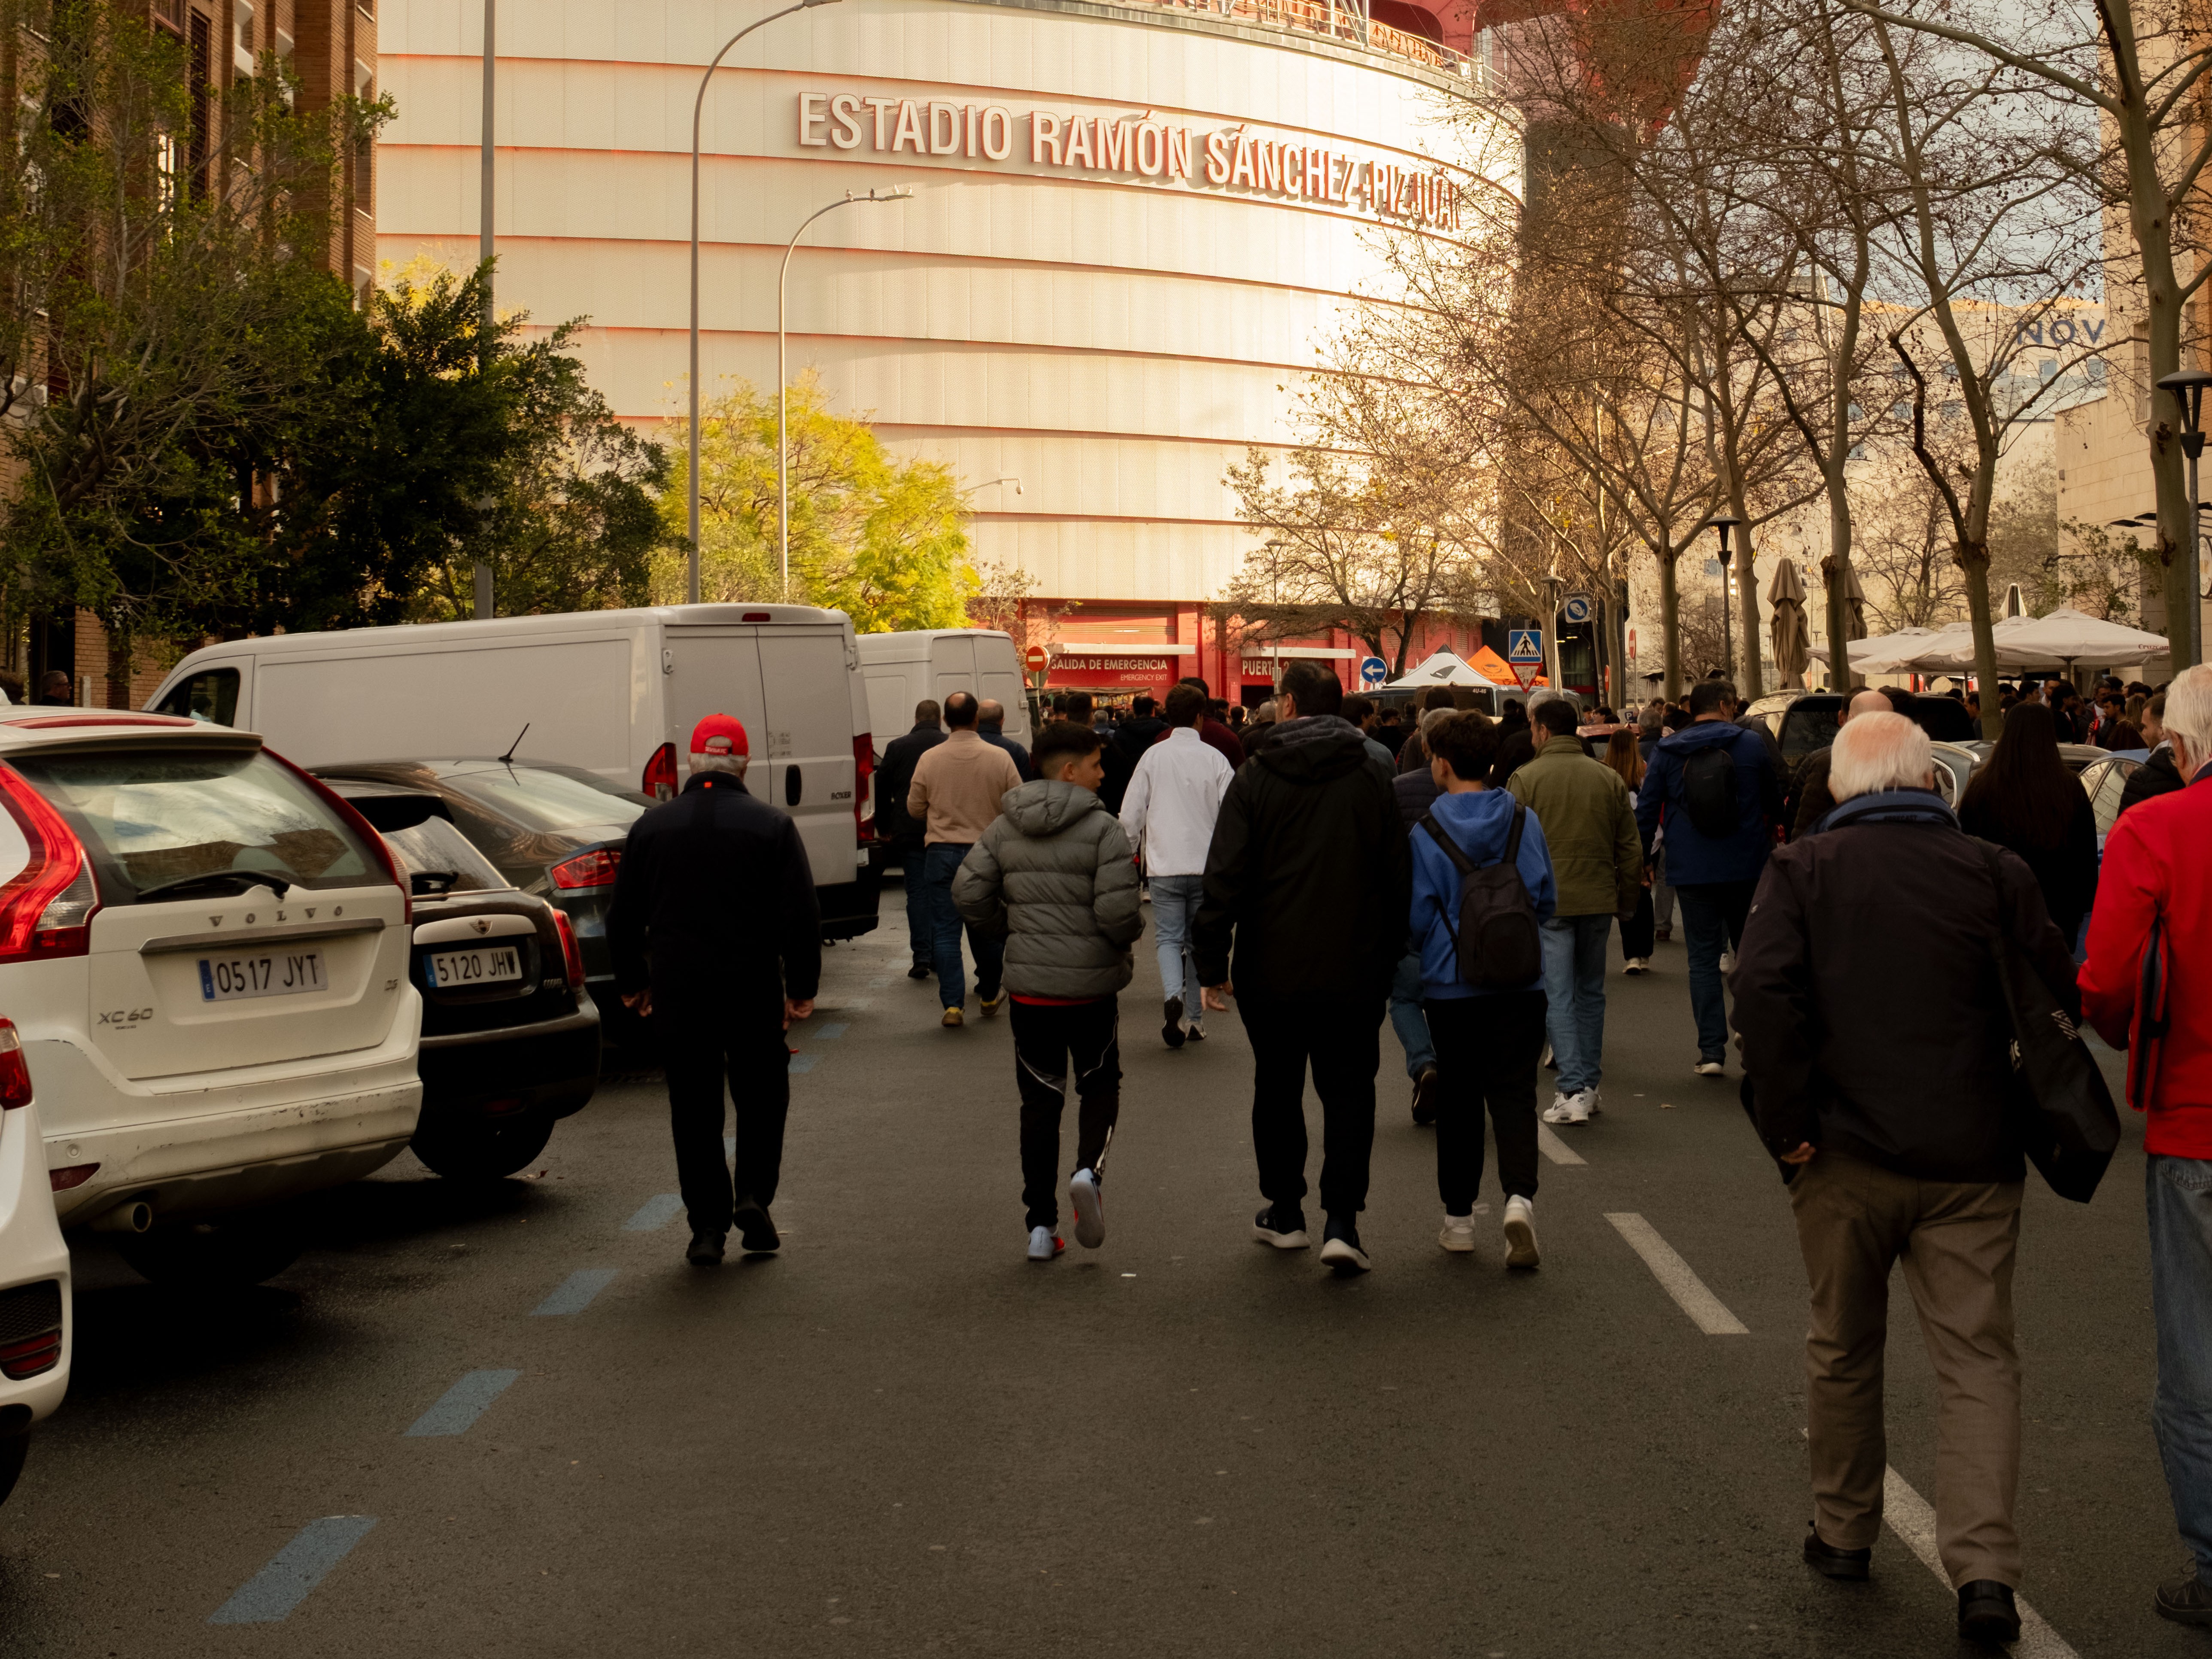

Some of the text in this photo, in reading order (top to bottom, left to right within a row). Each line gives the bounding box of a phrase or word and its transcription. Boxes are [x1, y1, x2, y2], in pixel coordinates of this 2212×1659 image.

[799, 91, 1013, 160] ESTADIO
[1030, 109, 1193, 179] RAMÓN
[2017, 319, 2105, 344] NOV
[1051, 659, 1168, 670] SALIDA DE EMERGENCIA
[1243, 660, 1273, 675] PUERT
[831, 791, 851, 799] BOXER
[209, 905, 343, 927] VOLVO
[216, 954, 317, 993] 0517 JYT
[437, 954, 482, 981] 5120
